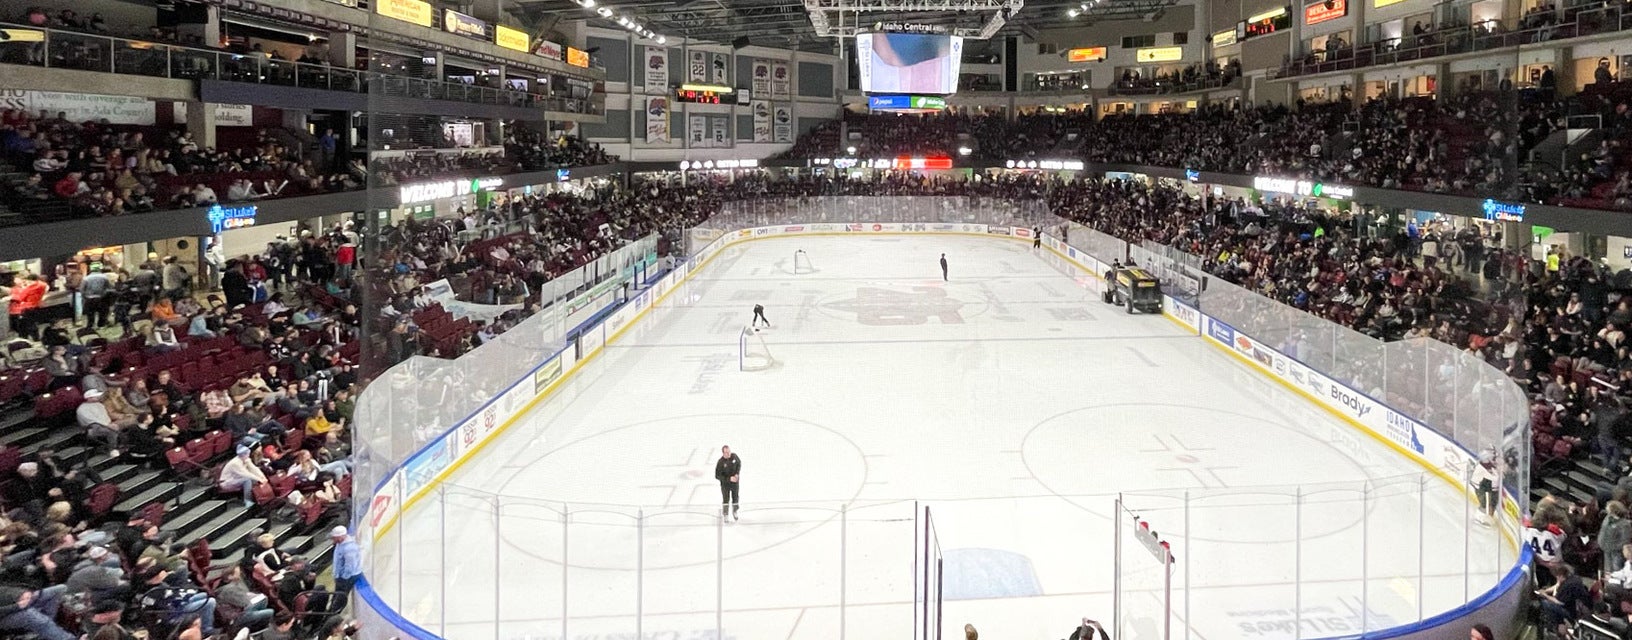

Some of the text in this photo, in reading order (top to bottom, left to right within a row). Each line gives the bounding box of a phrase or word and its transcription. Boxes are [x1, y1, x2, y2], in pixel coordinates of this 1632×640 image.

[883, 21, 903, 30] Idaho
[904, 22, 932, 31] Central
[401, 182, 455, 203] WELCOME
[1330, 385, 1365, 417] Brady
[1386, 410, 1410, 432] IDAHO
[1531, 537, 1555, 556] 44
